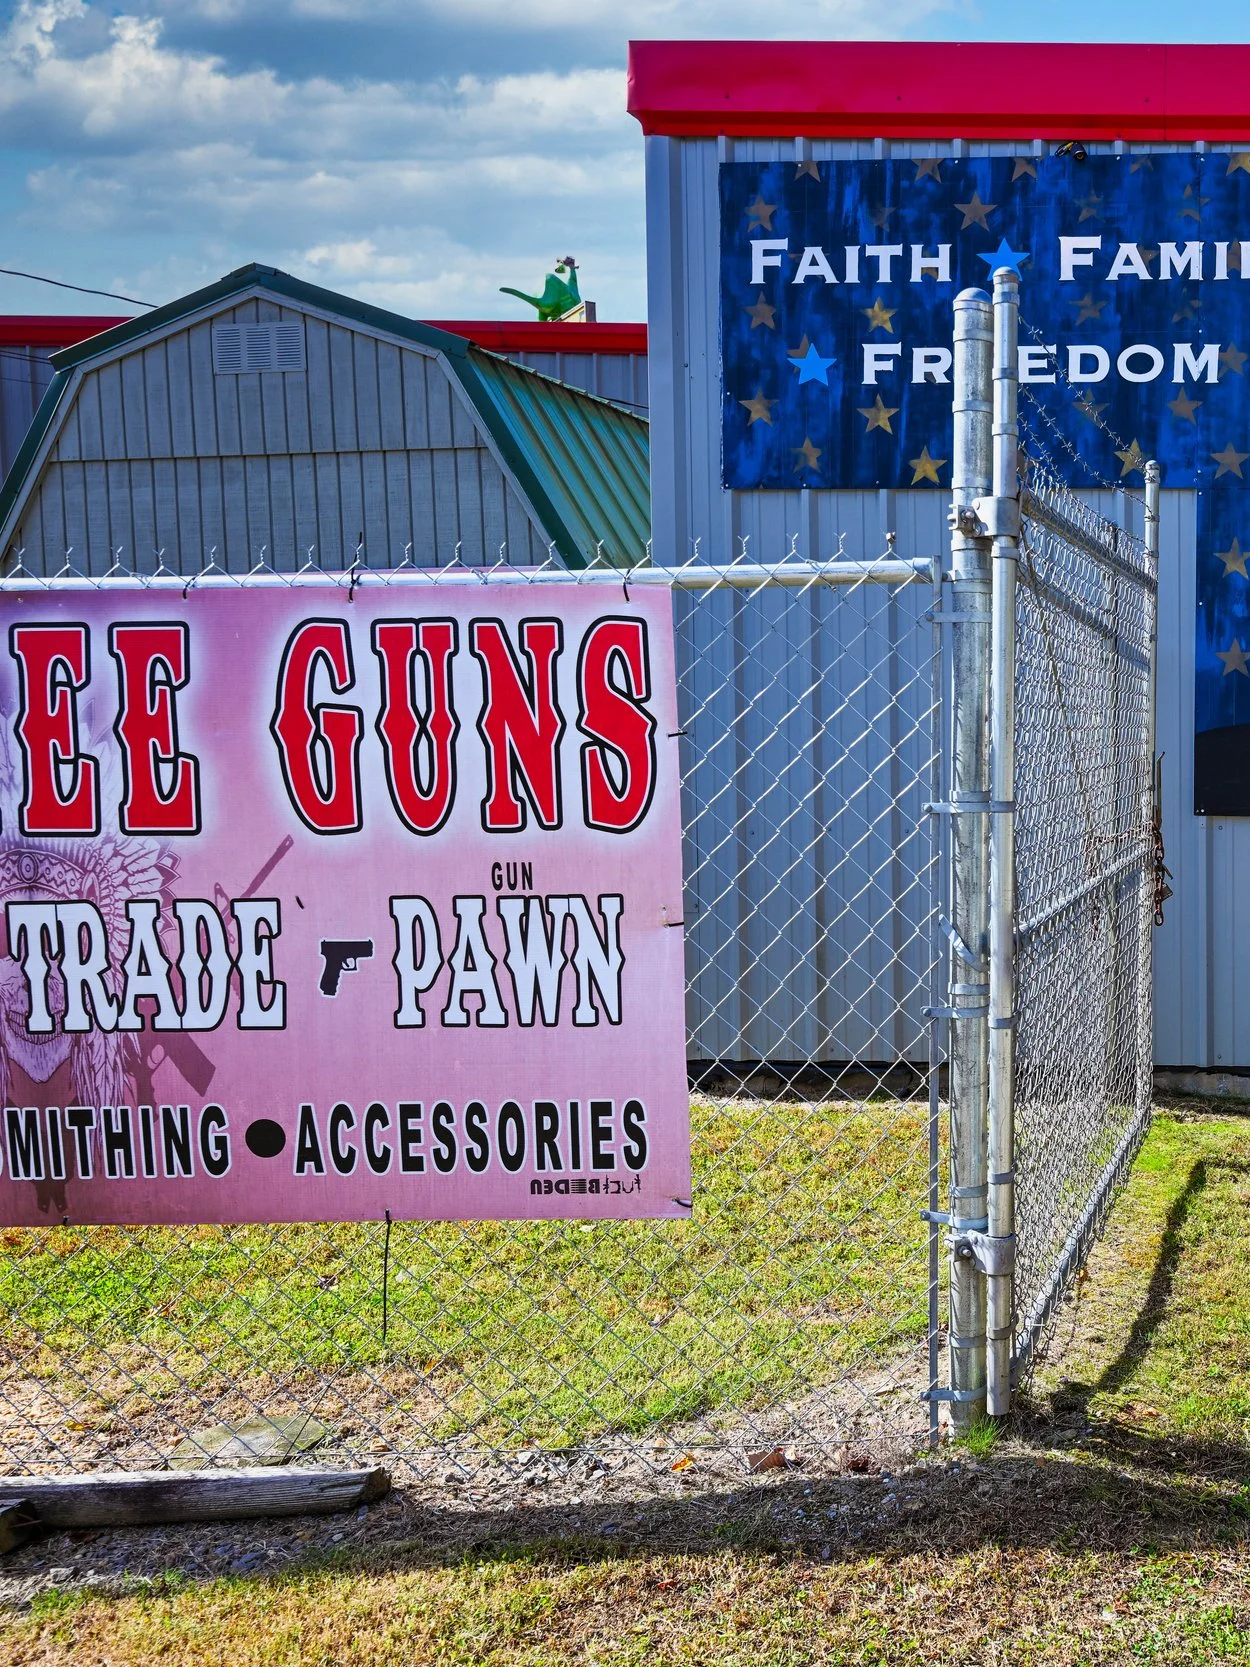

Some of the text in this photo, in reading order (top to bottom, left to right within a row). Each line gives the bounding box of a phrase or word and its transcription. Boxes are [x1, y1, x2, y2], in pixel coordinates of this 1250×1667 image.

[748, 237, 952, 284] FAITH
[861, 342, 1220, 386] FREDOM
[0, 615, 658, 836] EE GUNS
[491, 861, 534, 891] GUN
[5, 894, 626, 1033] TRADE PAWN
[0, 1099, 649, 1182] MITHING ACCESSORIES
